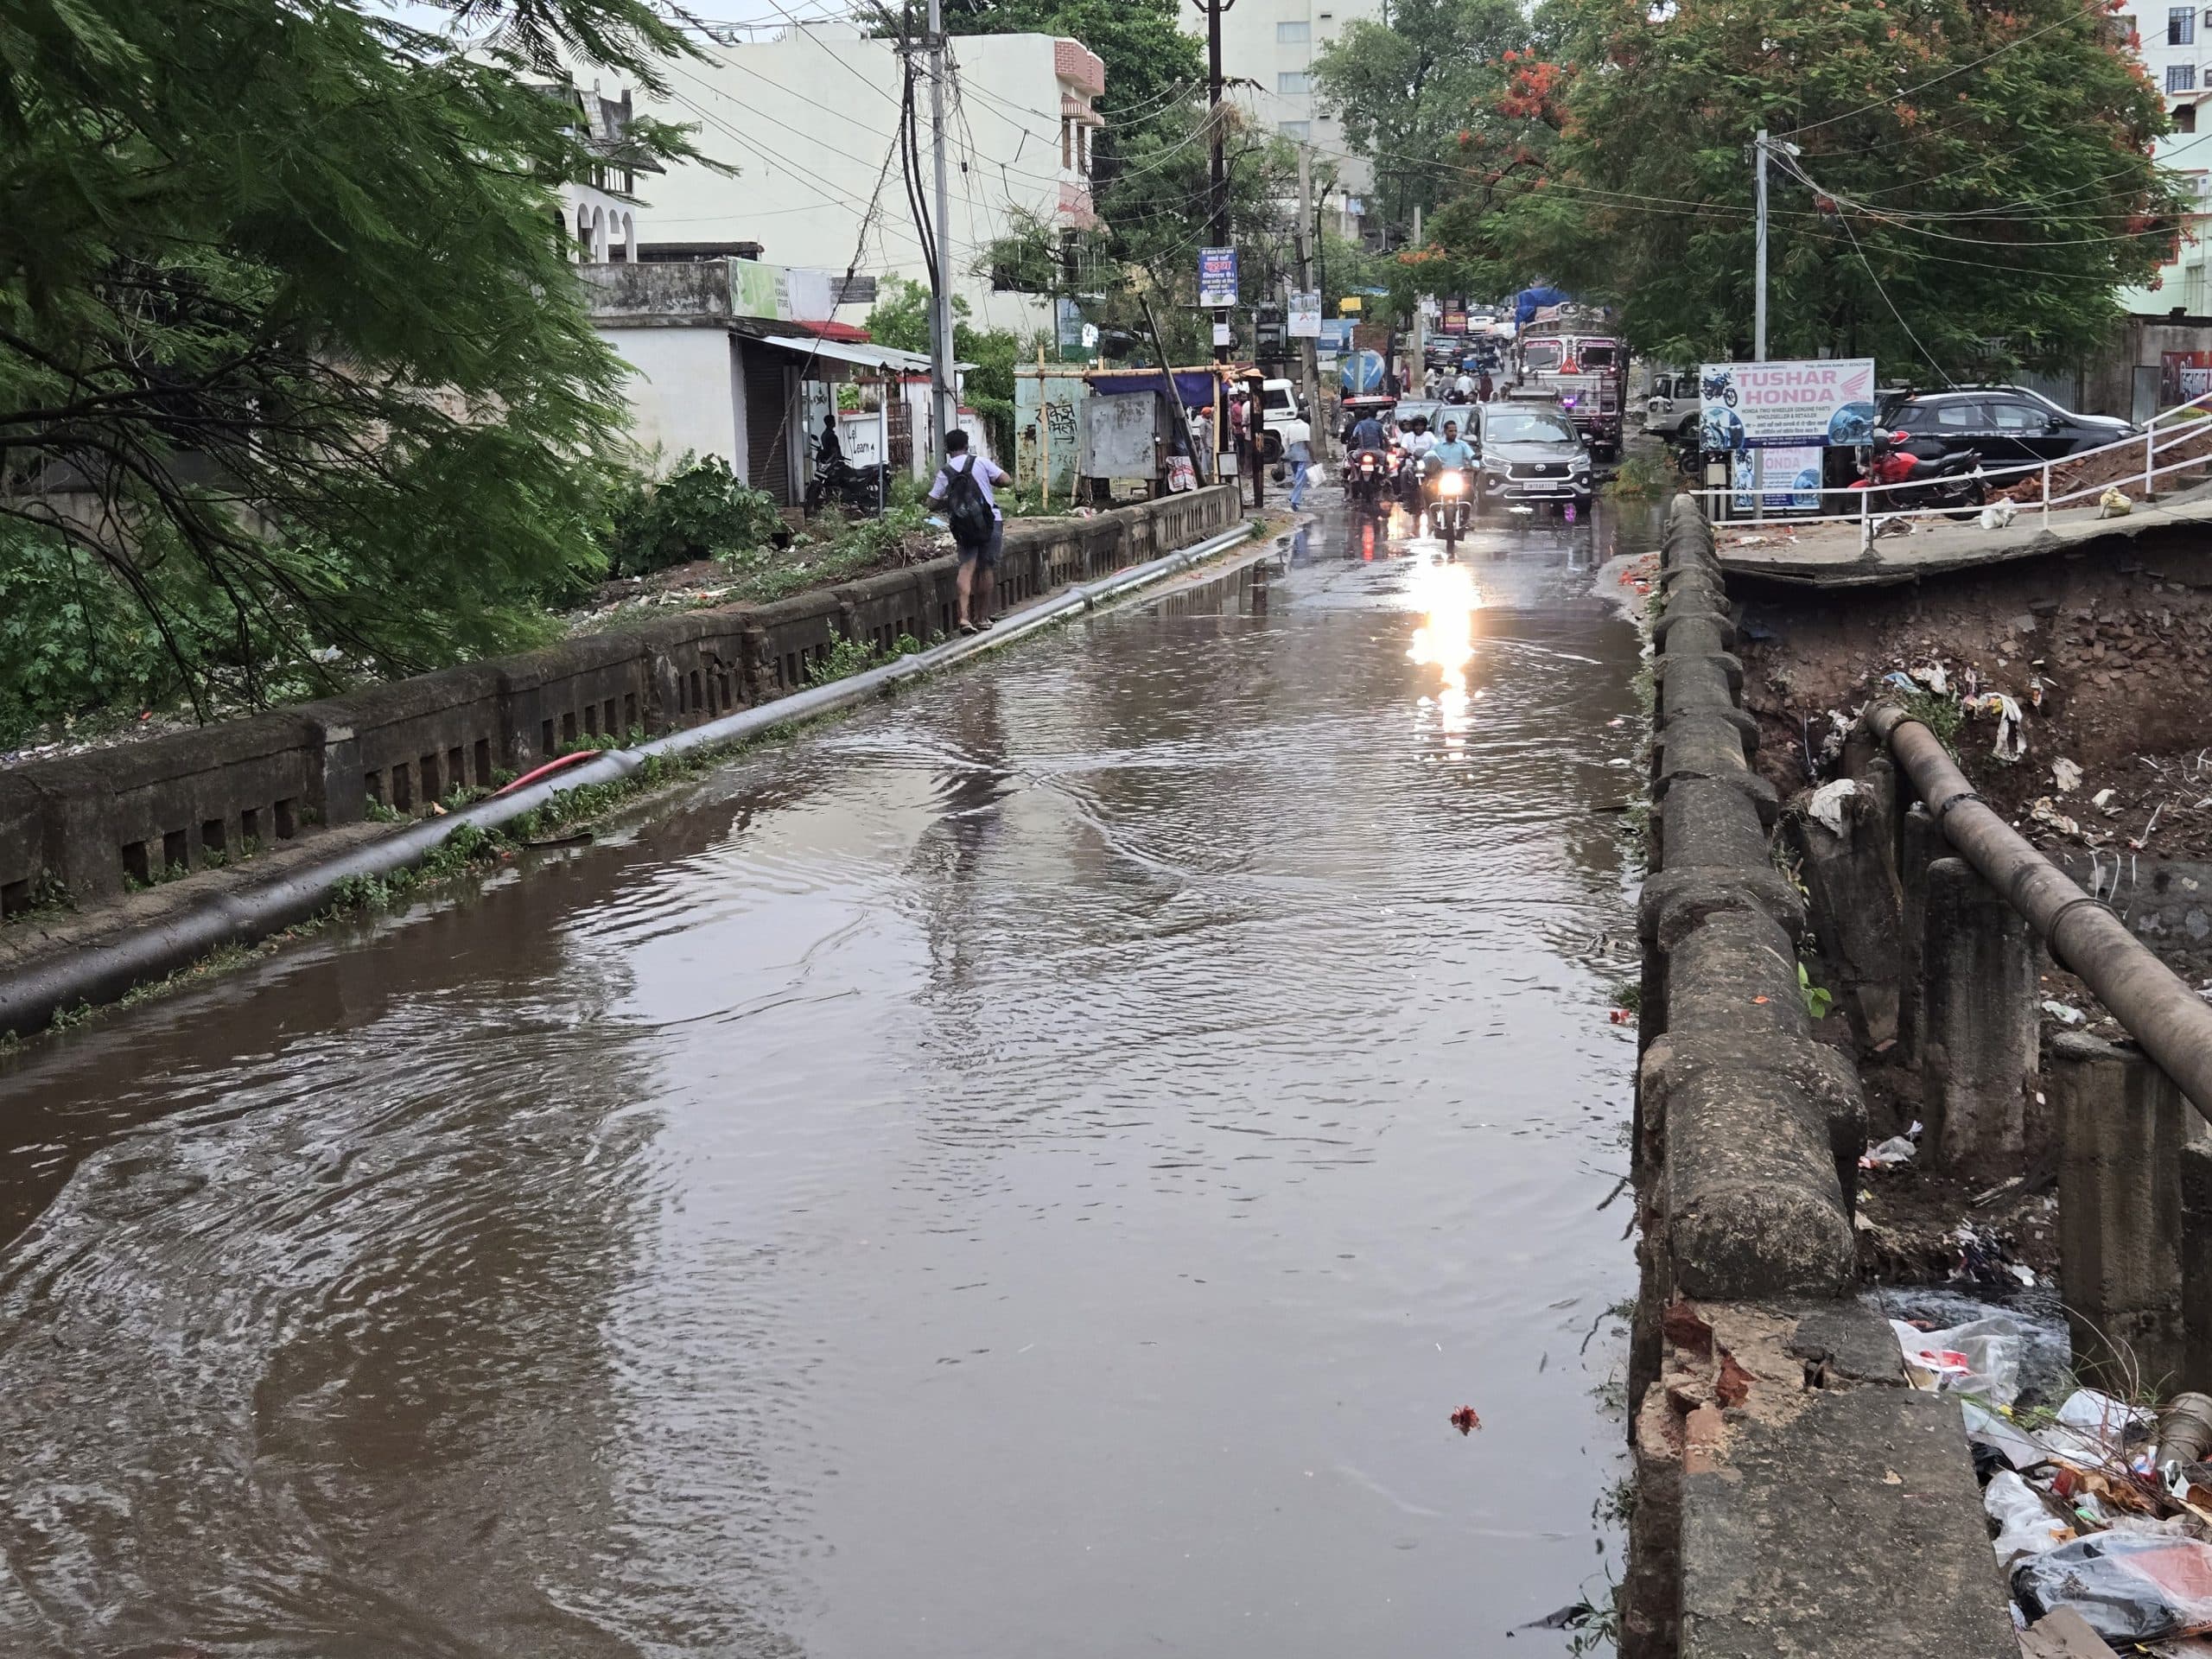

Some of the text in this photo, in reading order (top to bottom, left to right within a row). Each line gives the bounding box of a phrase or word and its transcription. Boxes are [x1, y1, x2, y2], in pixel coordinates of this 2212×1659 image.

[1737, 370, 1836, 387] TUSHAR
[1745, 389, 1835, 404] HONDA
[1764, 457, 1800, 469] ONDA
